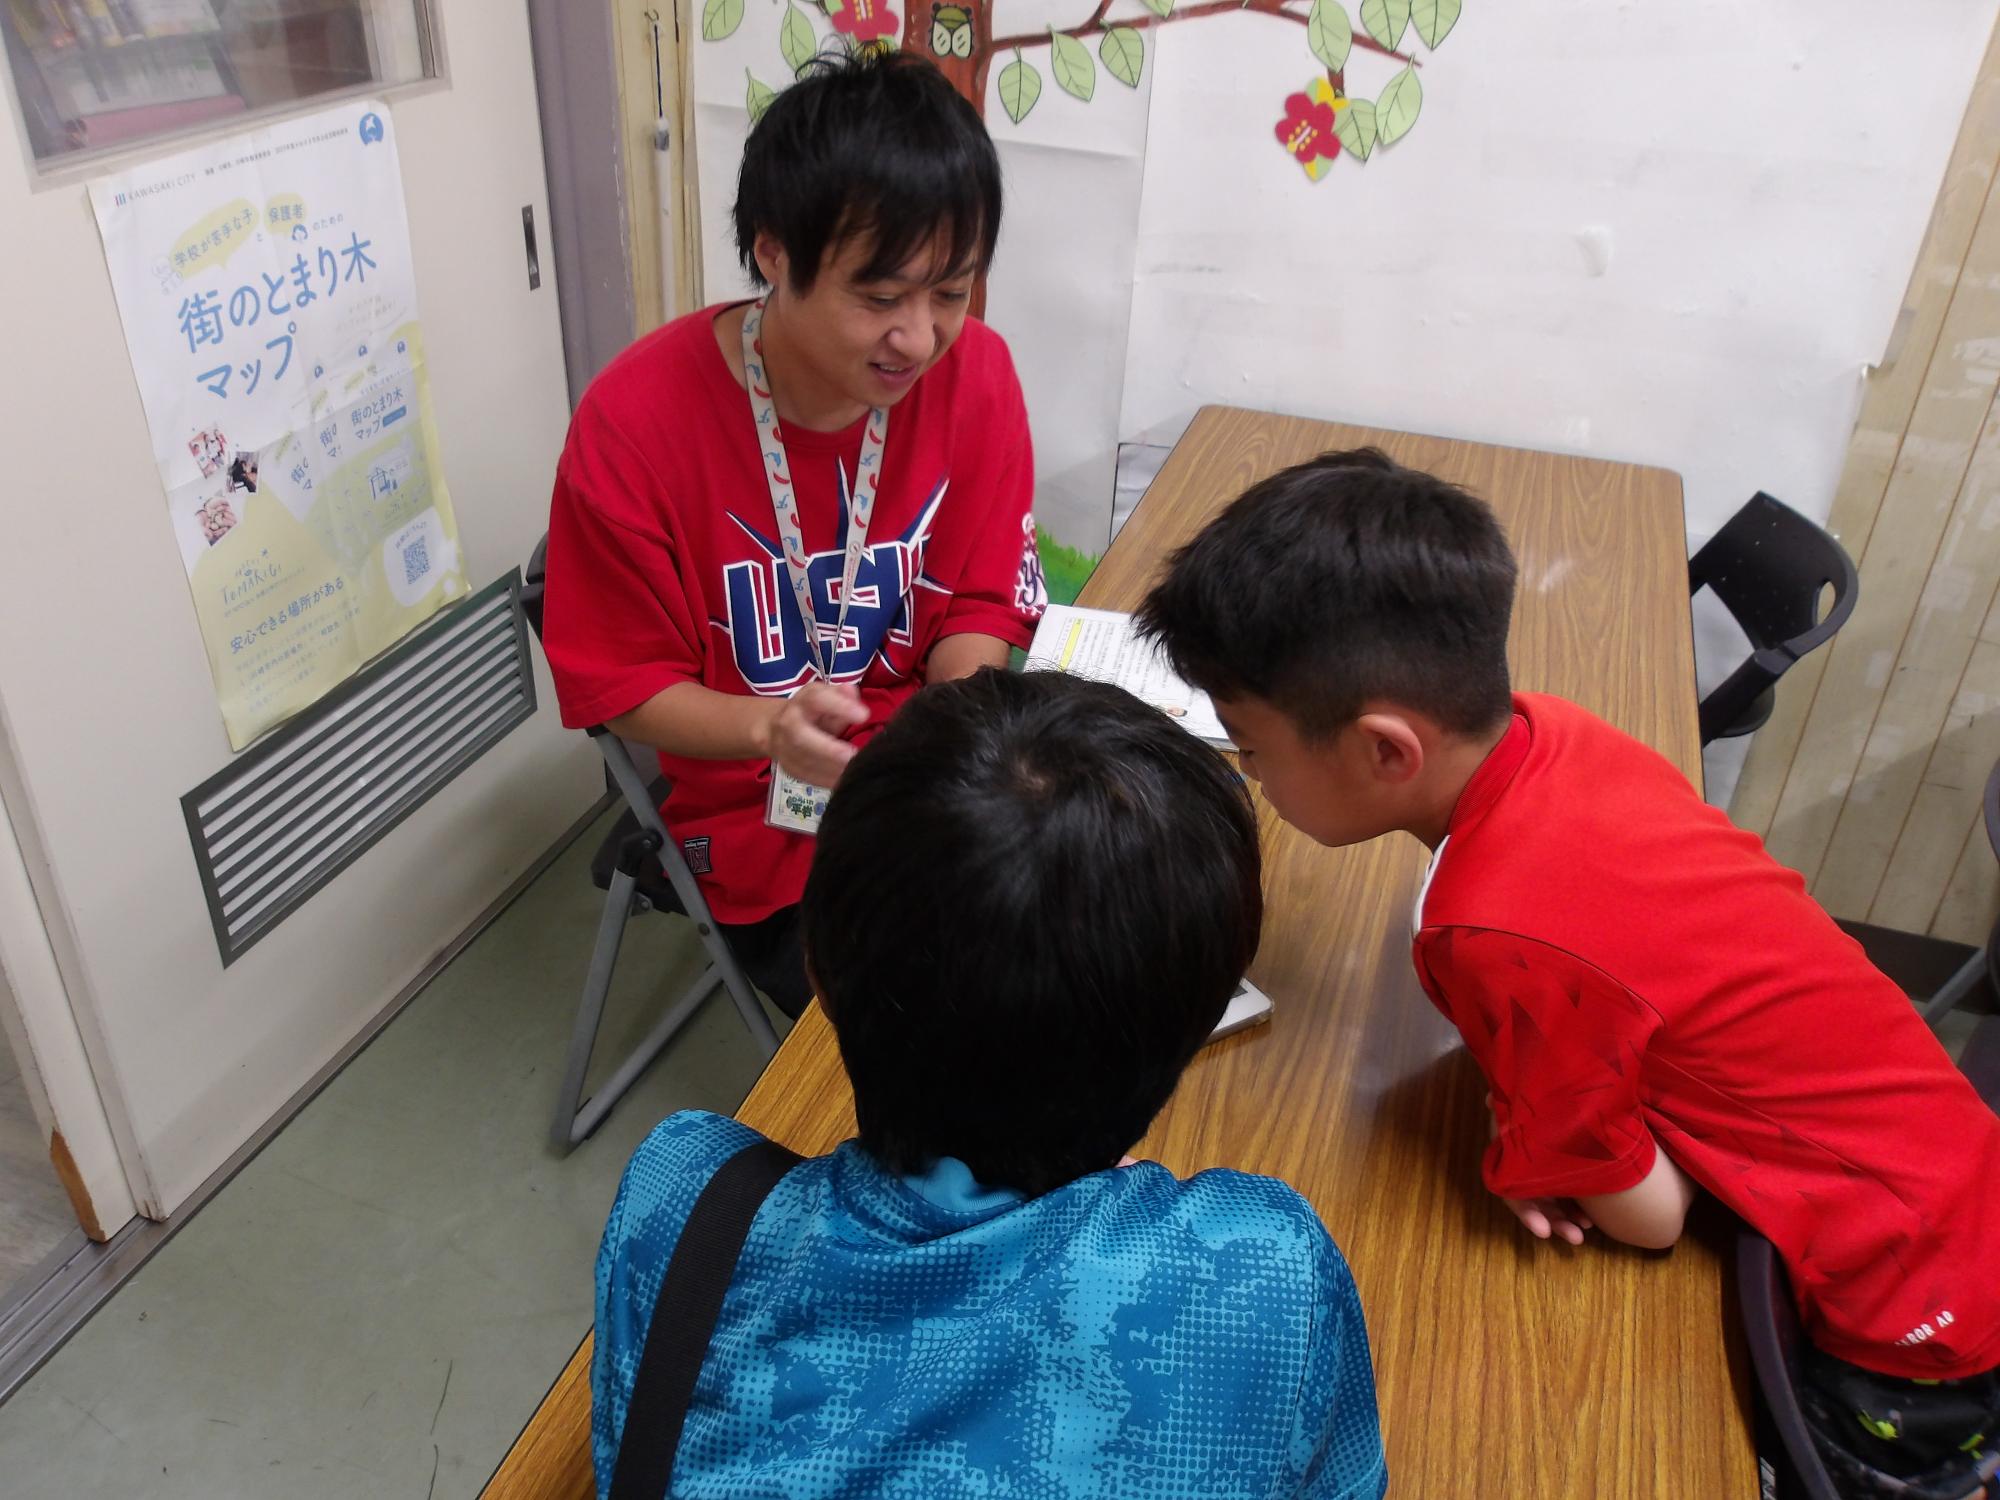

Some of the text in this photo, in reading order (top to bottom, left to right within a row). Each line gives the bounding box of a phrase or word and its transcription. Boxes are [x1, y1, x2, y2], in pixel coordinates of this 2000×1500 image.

[128, 173, 197, 201] KAWASAKI CITY
[174, 208, 253, 268] 学校が苦手な子
[313, 213, 344, 231] のための
[178, 231, 376, 354] 街のとまり木
[196, 321, 297, 399] マップ
[351, 387, 404, 426] 街のとまり木
[355, 415, 381, 440] マップ
[231, 577, 344, 655] 安心できる場所がある
